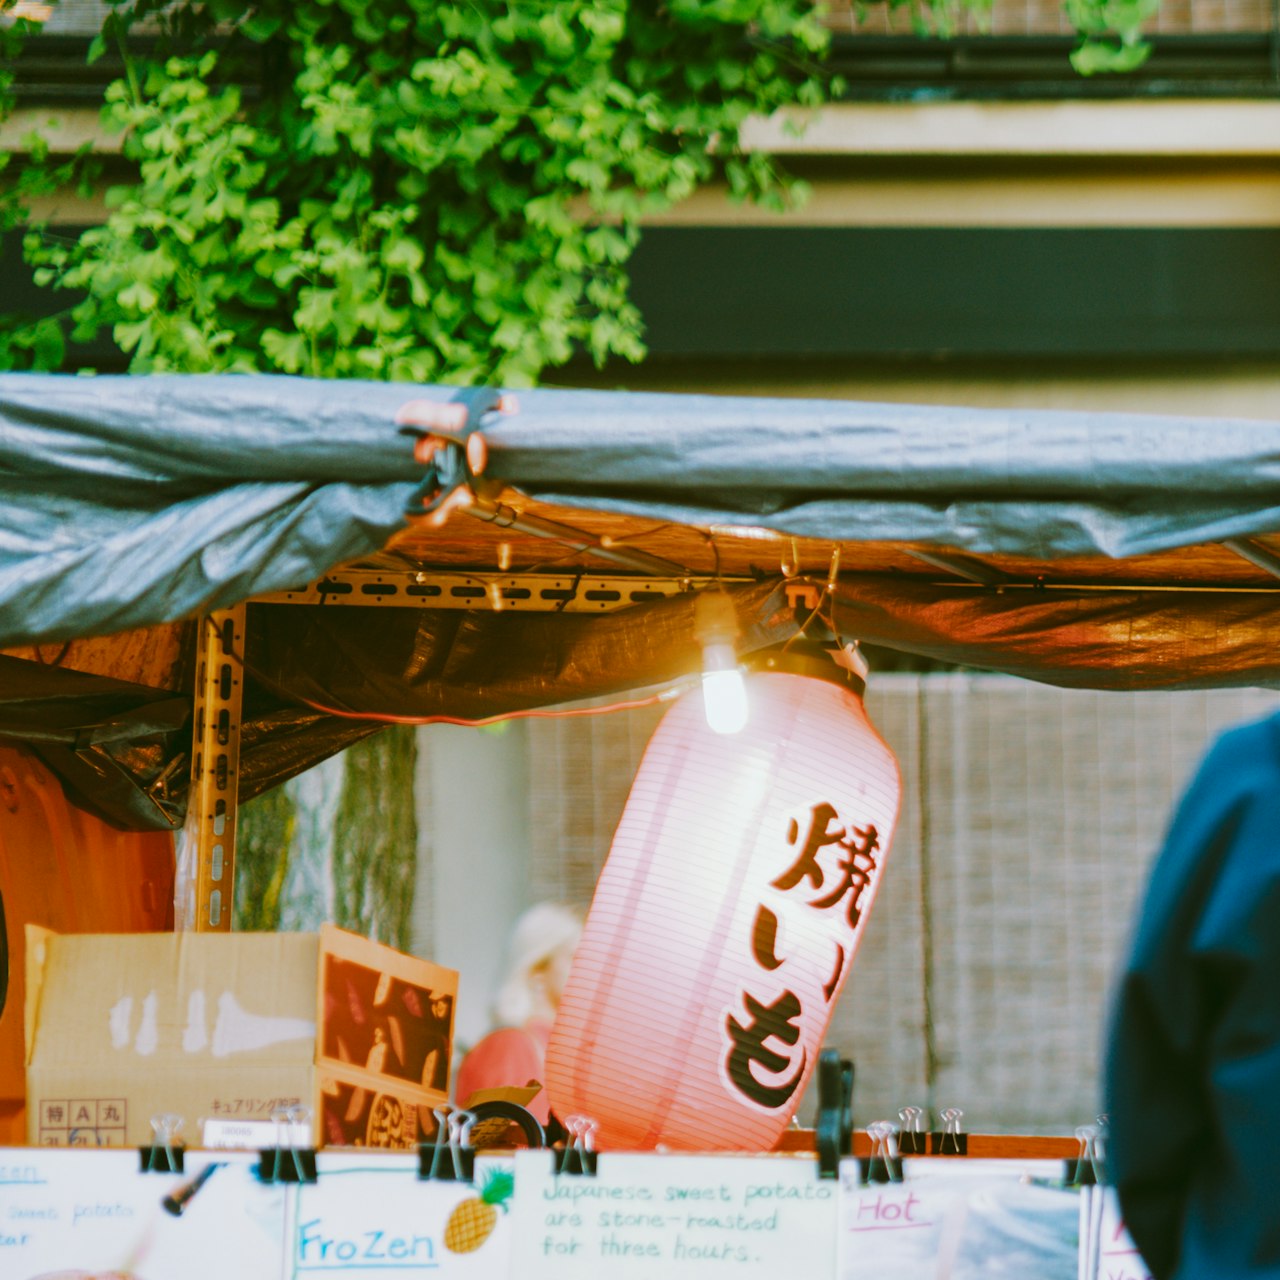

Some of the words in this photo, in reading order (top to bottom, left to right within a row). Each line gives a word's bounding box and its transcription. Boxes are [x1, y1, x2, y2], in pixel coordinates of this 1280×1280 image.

[726, 801, 880, 1110] 焼いも
[76, 1105, 91, 1122] A
[543, 1174, 653, 1206] Japanese
[665, 1184, 732, 1202] sweet
[744, 1181, 832, 1208] potato
[857, 1191, 921, 1222] Hot
[544, 1211, 582, 1228] are
[597, 1208, 780, 1232] stone-roasted
[541, 1234, 582, 1257] for
[600, 1231, 662, 1258] three
[673, 1233, 761, 1263] hours.
